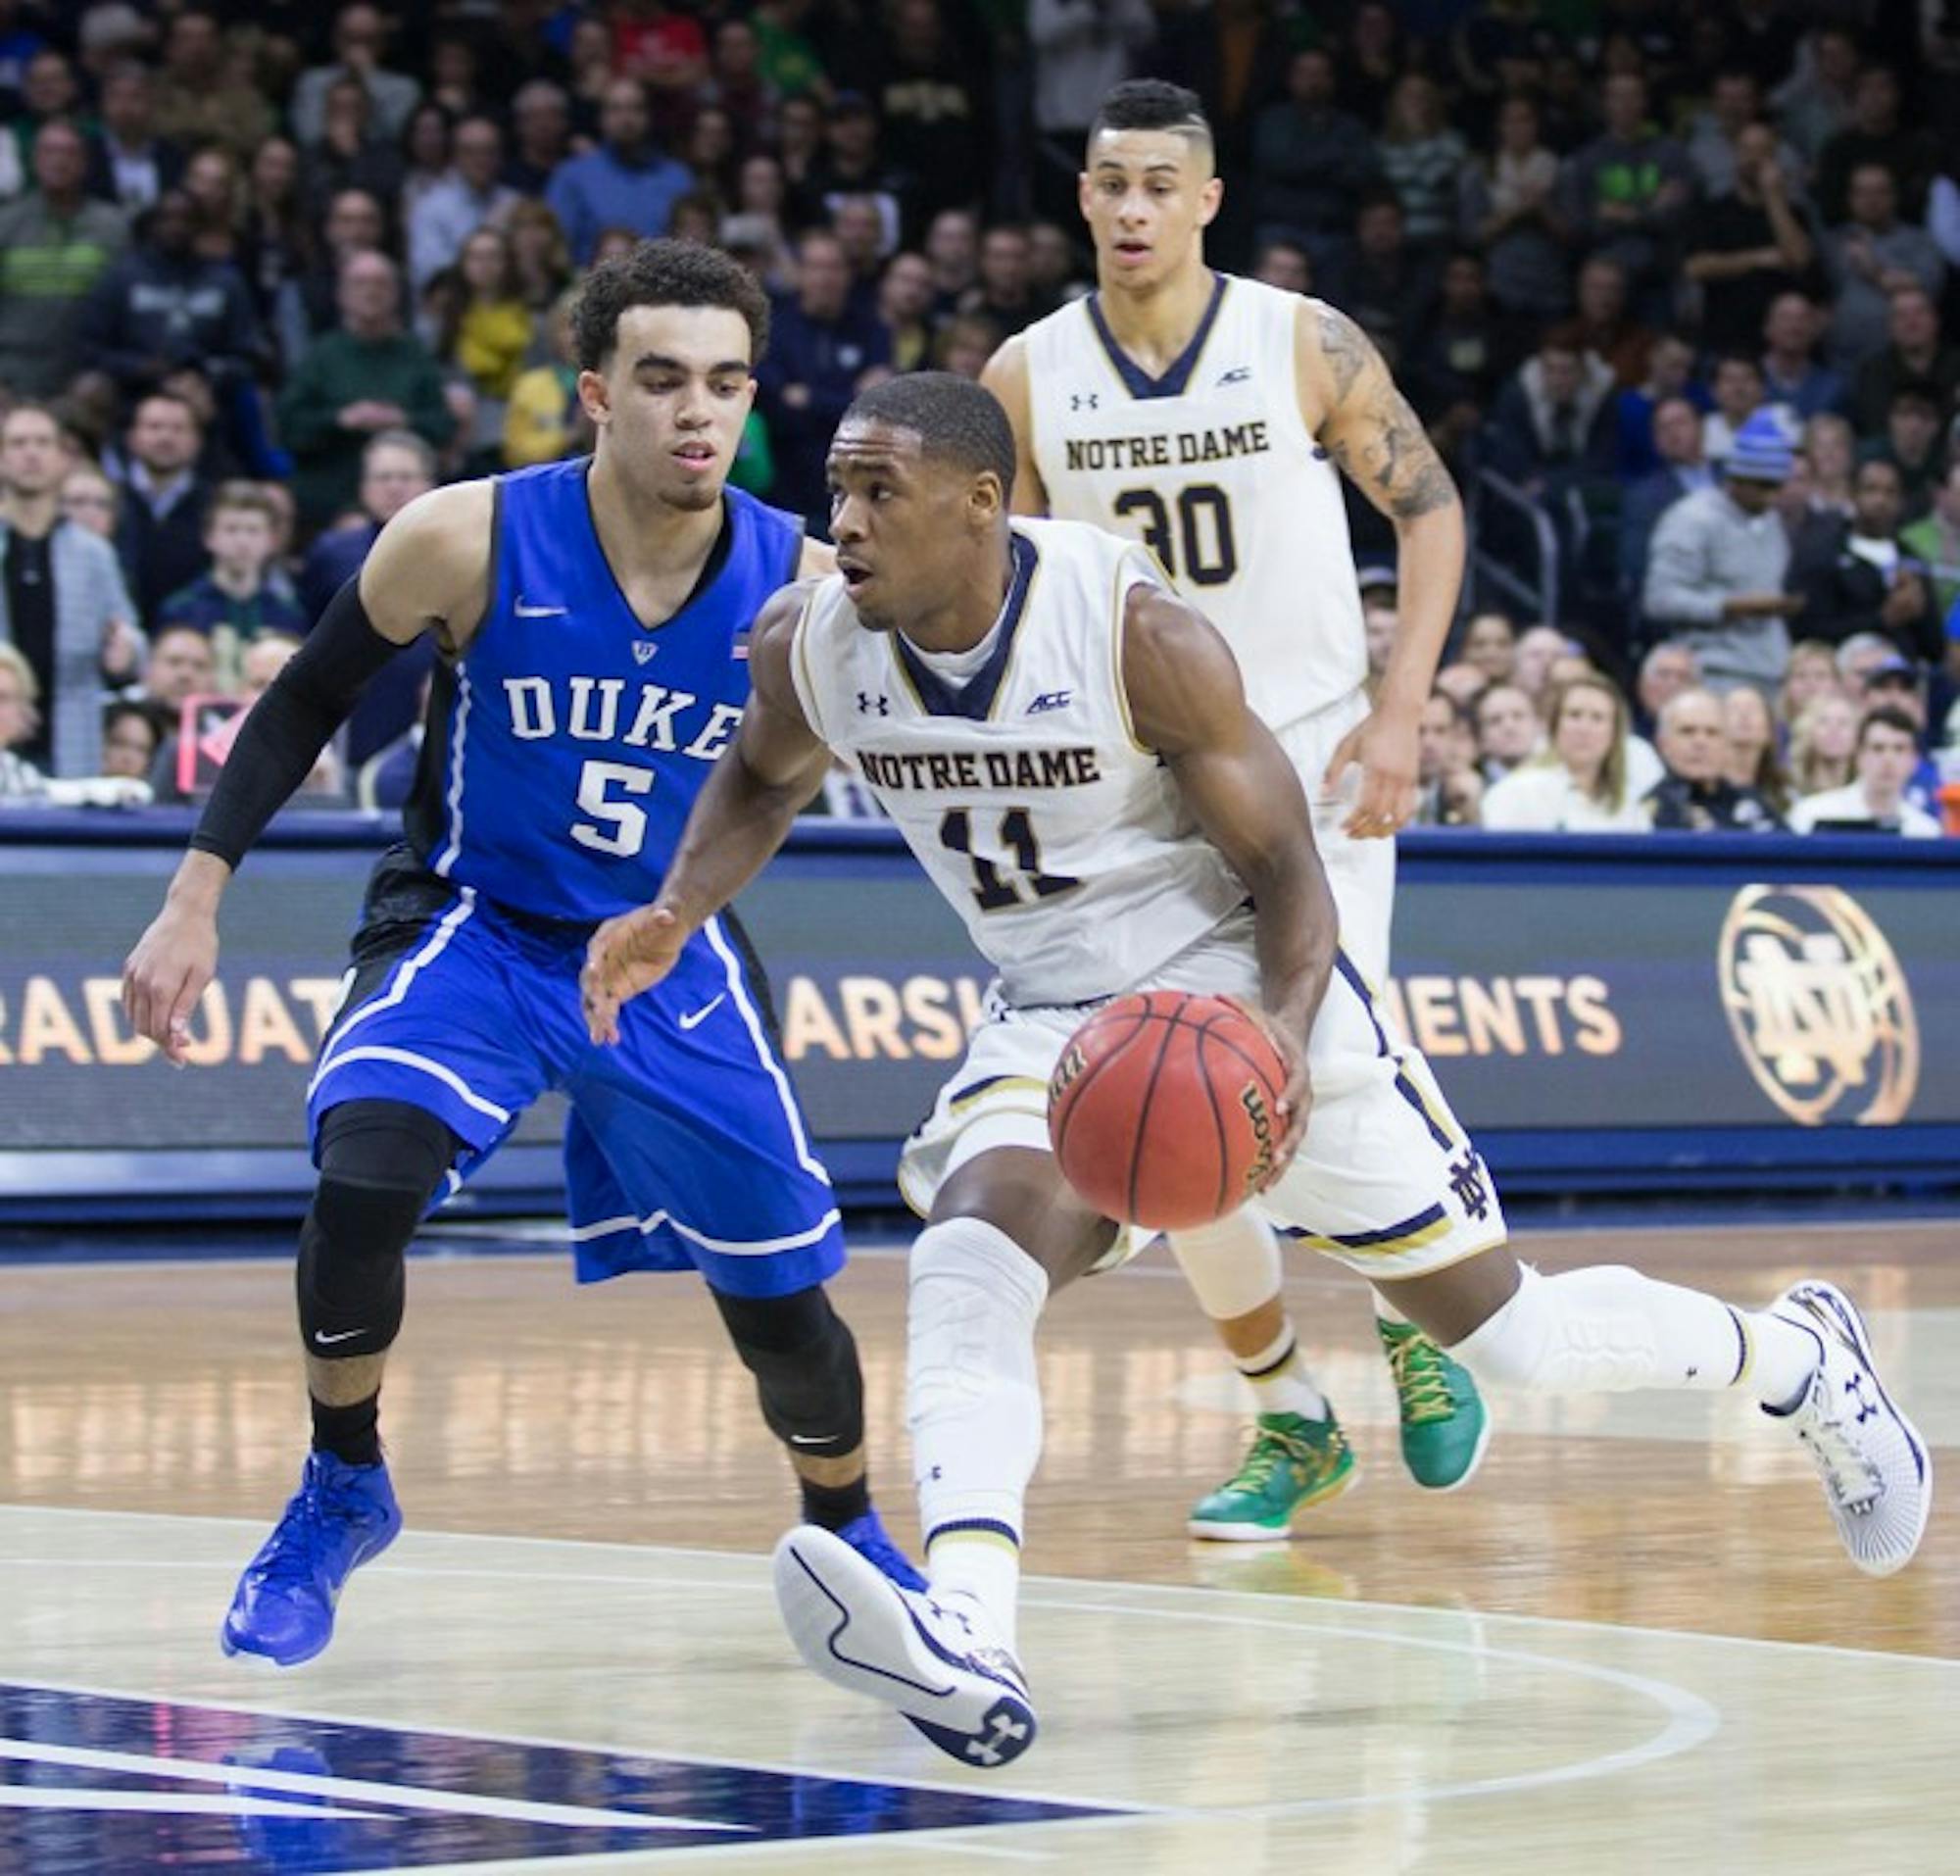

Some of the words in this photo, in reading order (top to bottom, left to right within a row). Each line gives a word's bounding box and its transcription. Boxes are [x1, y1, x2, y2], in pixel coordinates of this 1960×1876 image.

[1065, 434, 1169, 470] NOTRE
[1178, 421, 1270, 465] DAME
[1112, 483, 1238, 586] 30
[502, 675, 745, 761] DUKE
[1024, 690, 1072, 716] ACC
[569, 760, 655, 858] 5
[857, 749, 981, 789] NOTRE
[985, 747, 1102, 788] DAME
[940, 806, 1087, 912] 11
[1386, 974, 1623, 1056] ENTS
